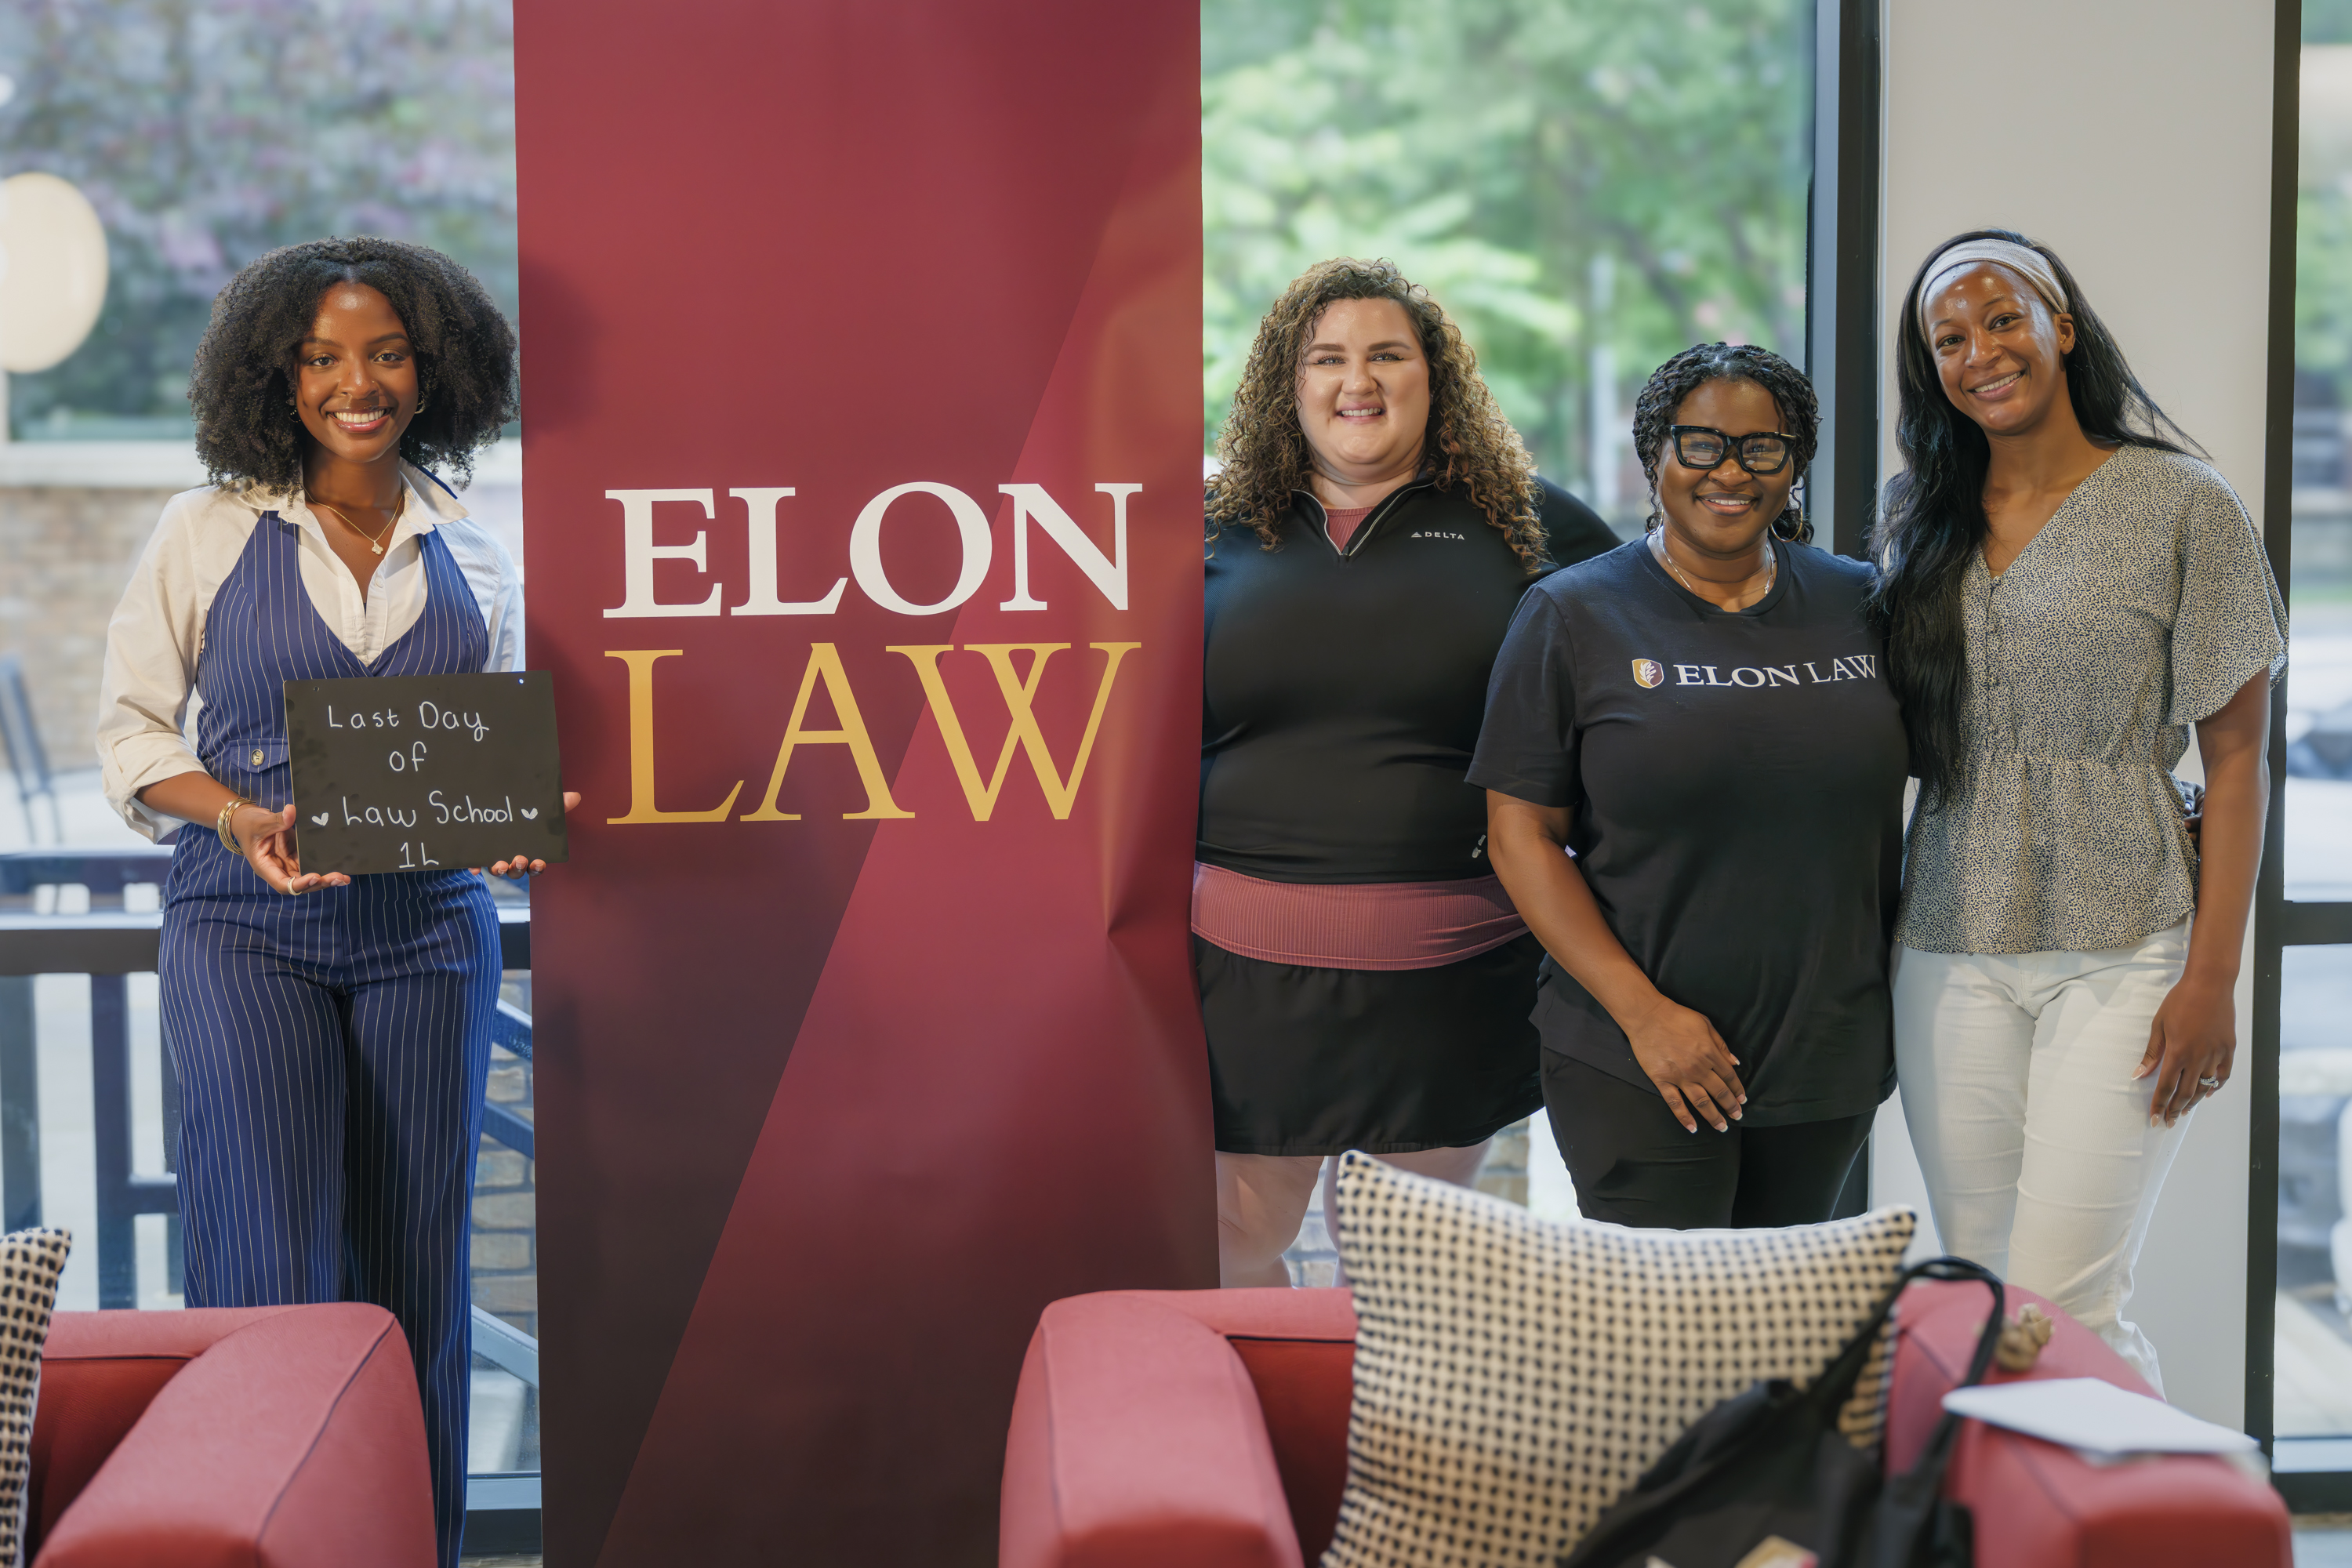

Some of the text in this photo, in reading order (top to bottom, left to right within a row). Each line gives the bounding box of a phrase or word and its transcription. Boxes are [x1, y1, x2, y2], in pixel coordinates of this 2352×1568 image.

[603, 481, 1143, 618] ELON
[1425, 532, 1465, 540] DELTA
[1673, 655, 1876, 688] ELON LAW
[328, 701, 489, 742] Last Day
[604, 641, 1142, 824] LAW
[389, 741, 427, 772] of
[343, 790, 513, 828] Law School
[398, 842, 439, 869] 1L
